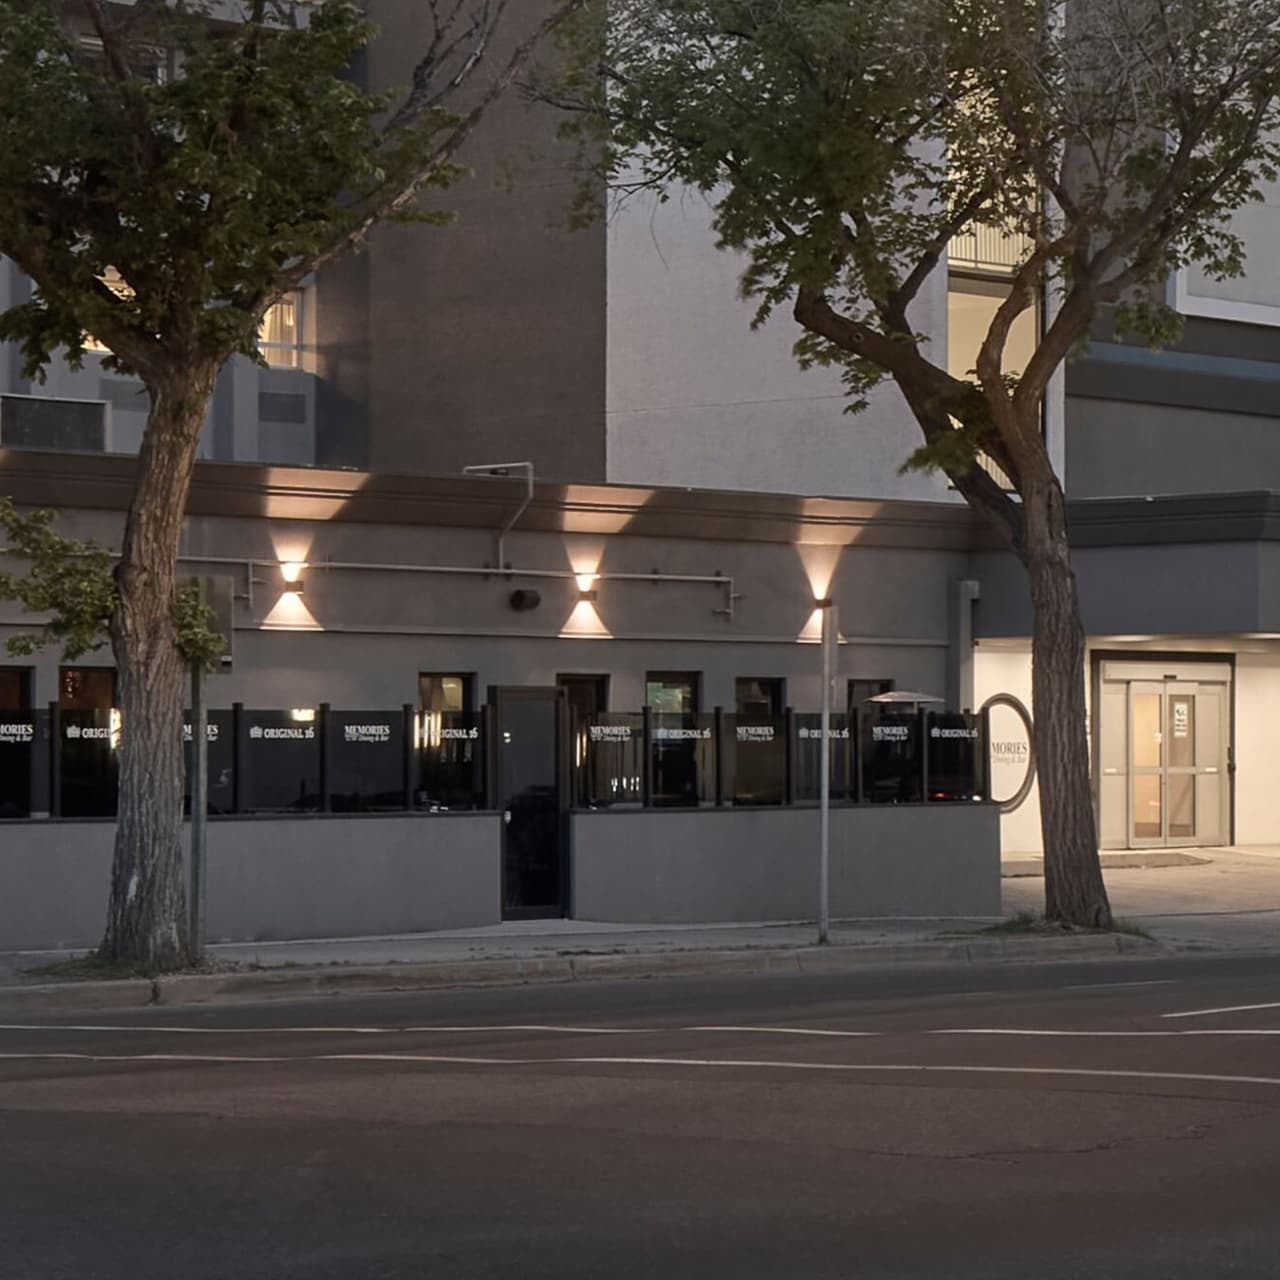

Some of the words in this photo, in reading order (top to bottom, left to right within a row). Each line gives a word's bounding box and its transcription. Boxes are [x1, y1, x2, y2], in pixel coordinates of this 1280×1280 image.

[82, 728, 111, 738] ORIGI
[264, 728, 304, 738] ORIGINAL
[305, 726, 315, 738] 16
[344, 725, 390, 735] MEMORIES
[992, 742, 1027, 754] MORIES
